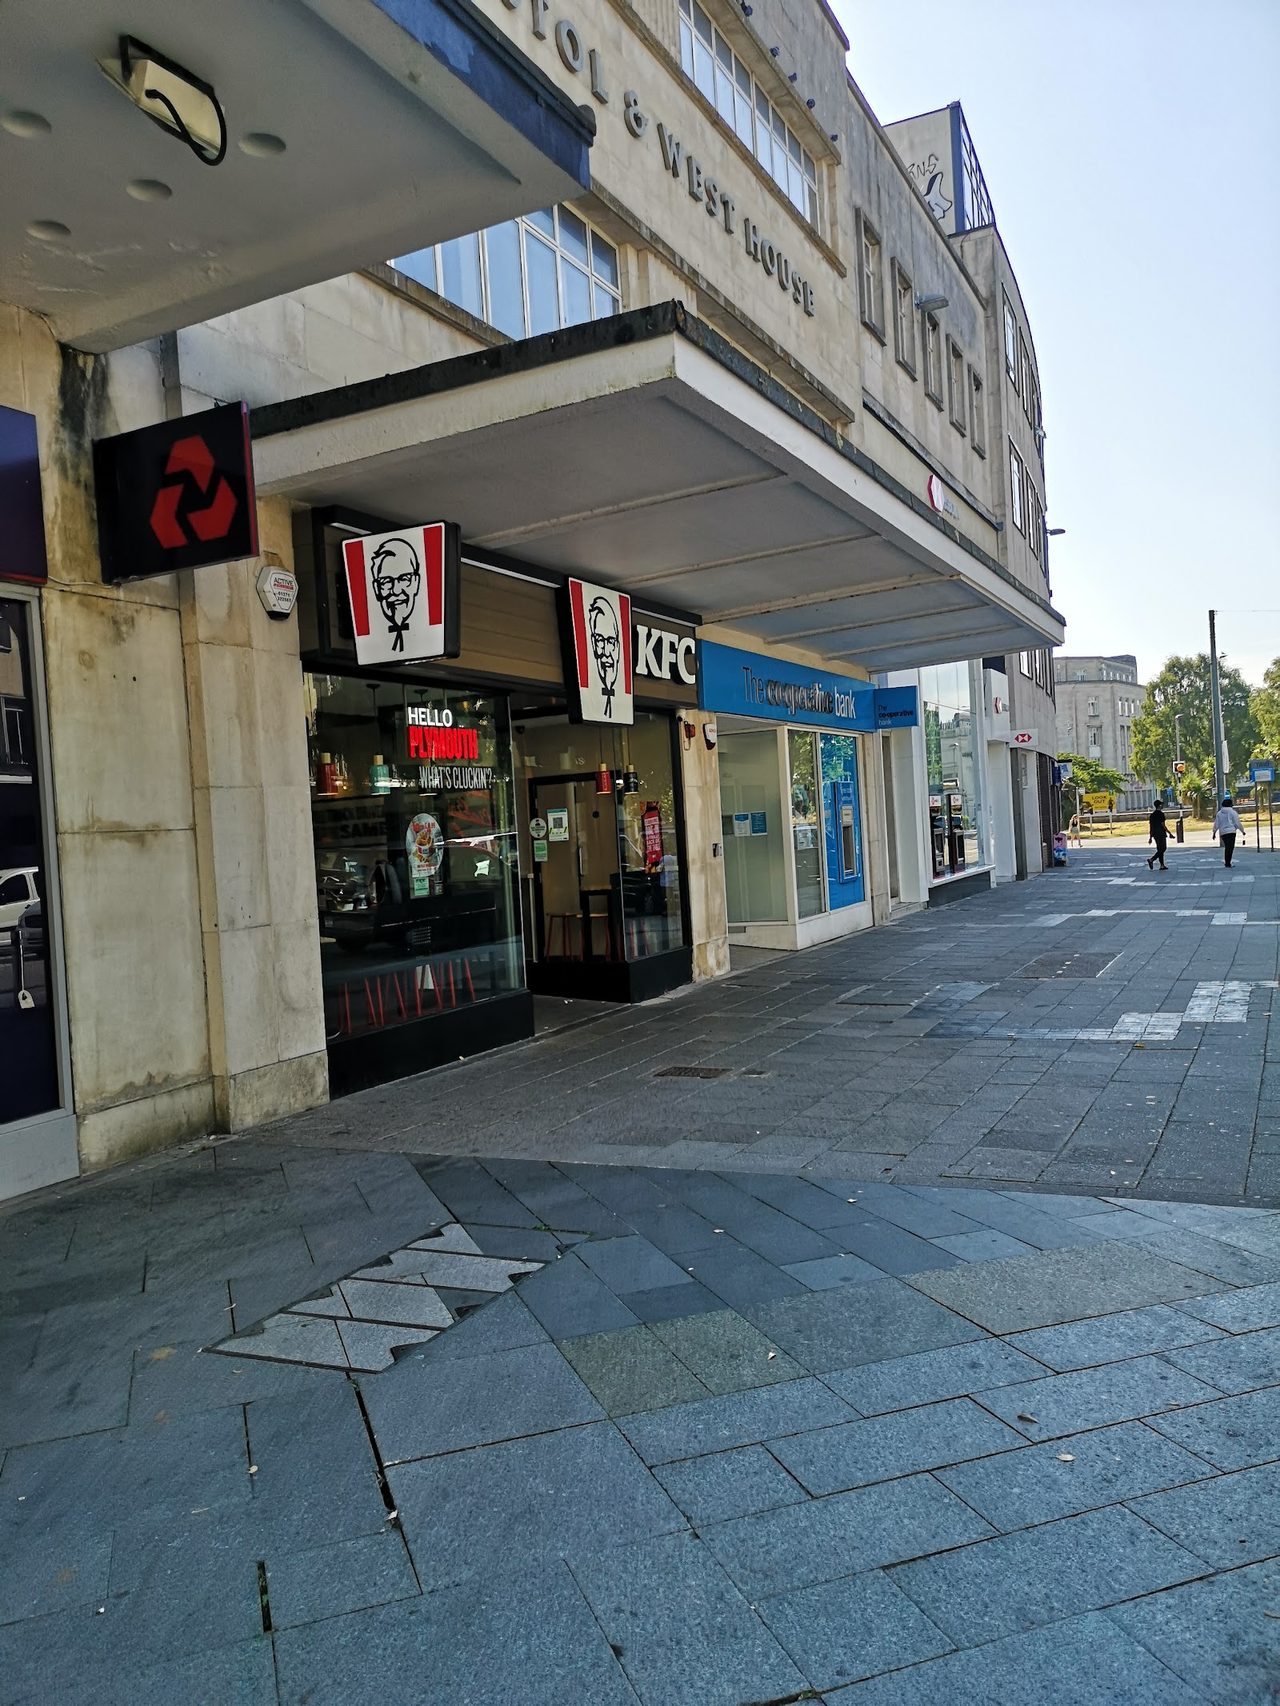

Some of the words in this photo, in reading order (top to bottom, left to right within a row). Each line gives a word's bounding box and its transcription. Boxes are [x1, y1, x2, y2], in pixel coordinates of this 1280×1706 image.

[501, 0, 608, 105] TOL
[624, 90, 648, 139] &
[657, 122, 736, 235] WEST
[744, 218, 815, 318] HOUSE
[274, 577, 293, 586] ACTIVE
[635, 624, 696, 685] KFC
[742, 666, 765, 705] The
[766, 680, 833, 715] co-operative
[834, 685, 857, 719] bank
[407, 706, 453, 728] HELLO
[408, 725, 479, 760] PLYMOUTH
[418, 766, 452, 790] WHAT'S
[452, 767, 493, 790] CLUCKIN'?
